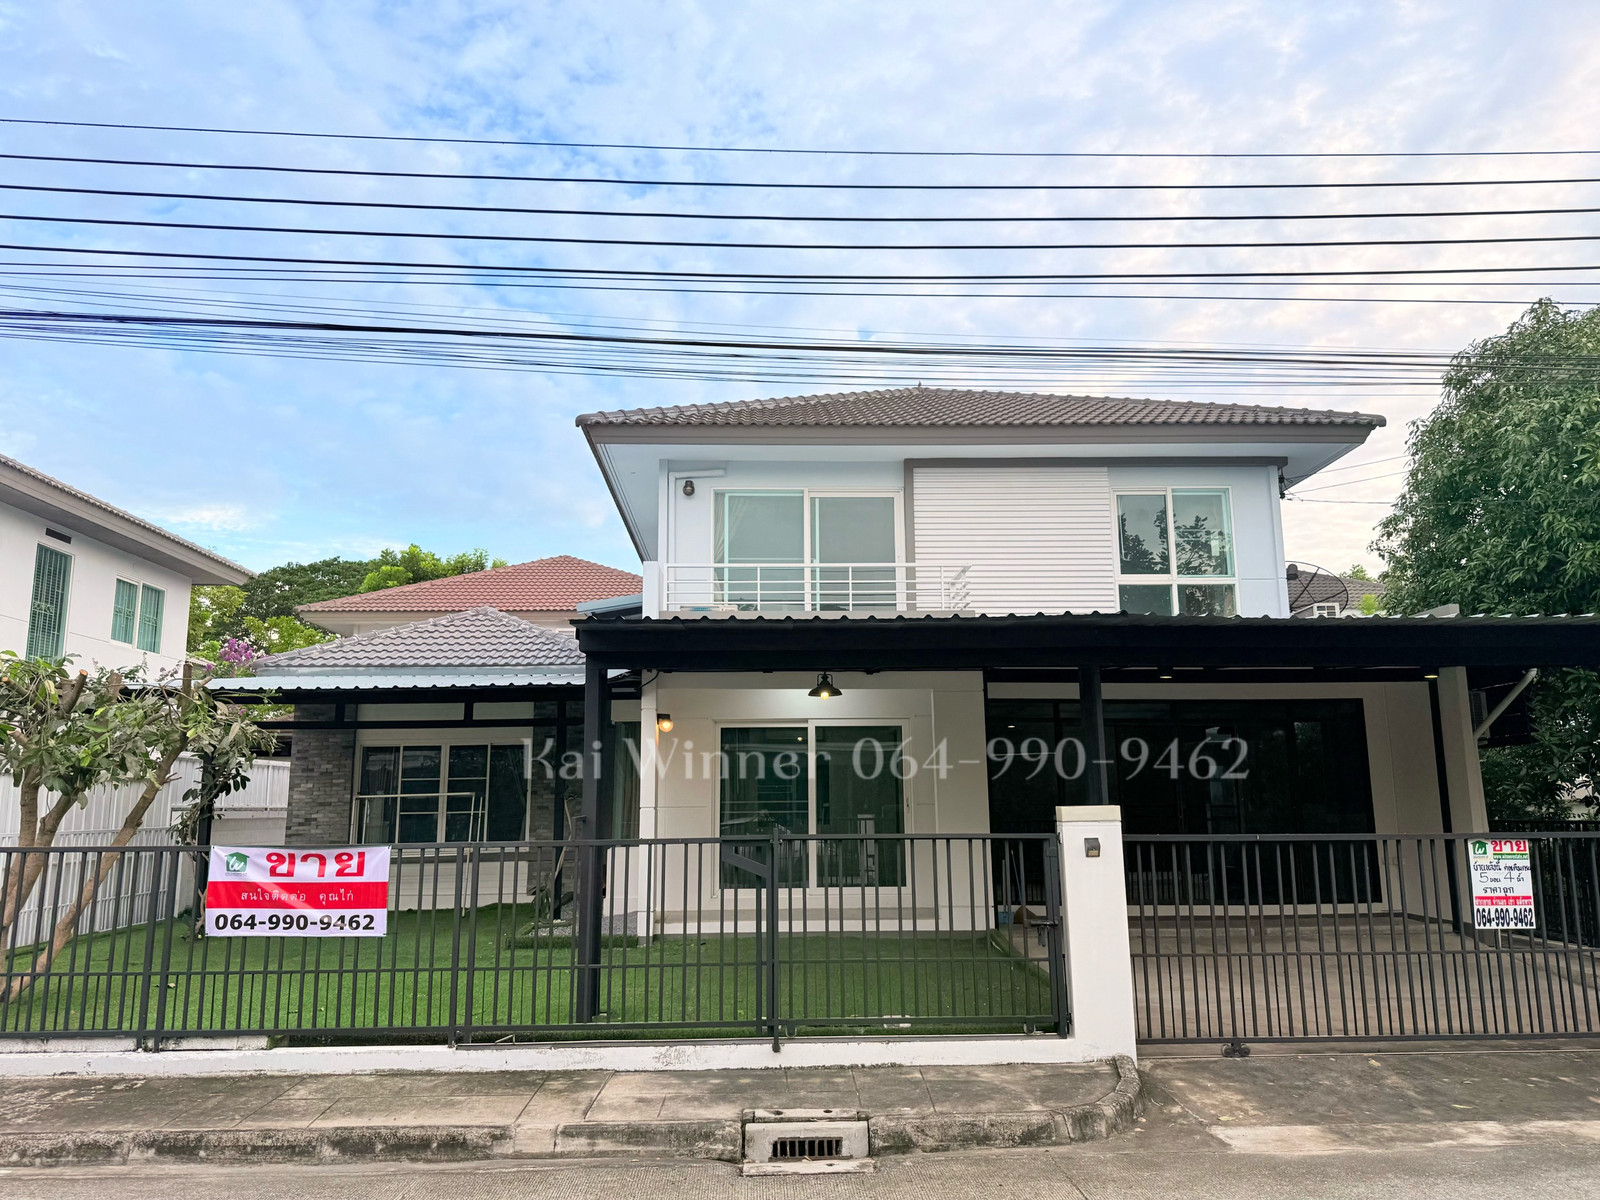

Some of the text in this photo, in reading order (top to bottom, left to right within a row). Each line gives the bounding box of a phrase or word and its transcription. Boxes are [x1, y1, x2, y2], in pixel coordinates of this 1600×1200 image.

[1491, 840, 1527, 852] ขาย
[266, 852, 366, 878] ขาย
[1479, 872, 1489, 883] 5
[1503, 871, 1515, 883] 4
[241, 888, 354, 905] สนใจติดต่อ คุณไก่
[215, 914, 375, 931] 064-990-9462
[1476, 908, 1534, 927] 064-990-9462
